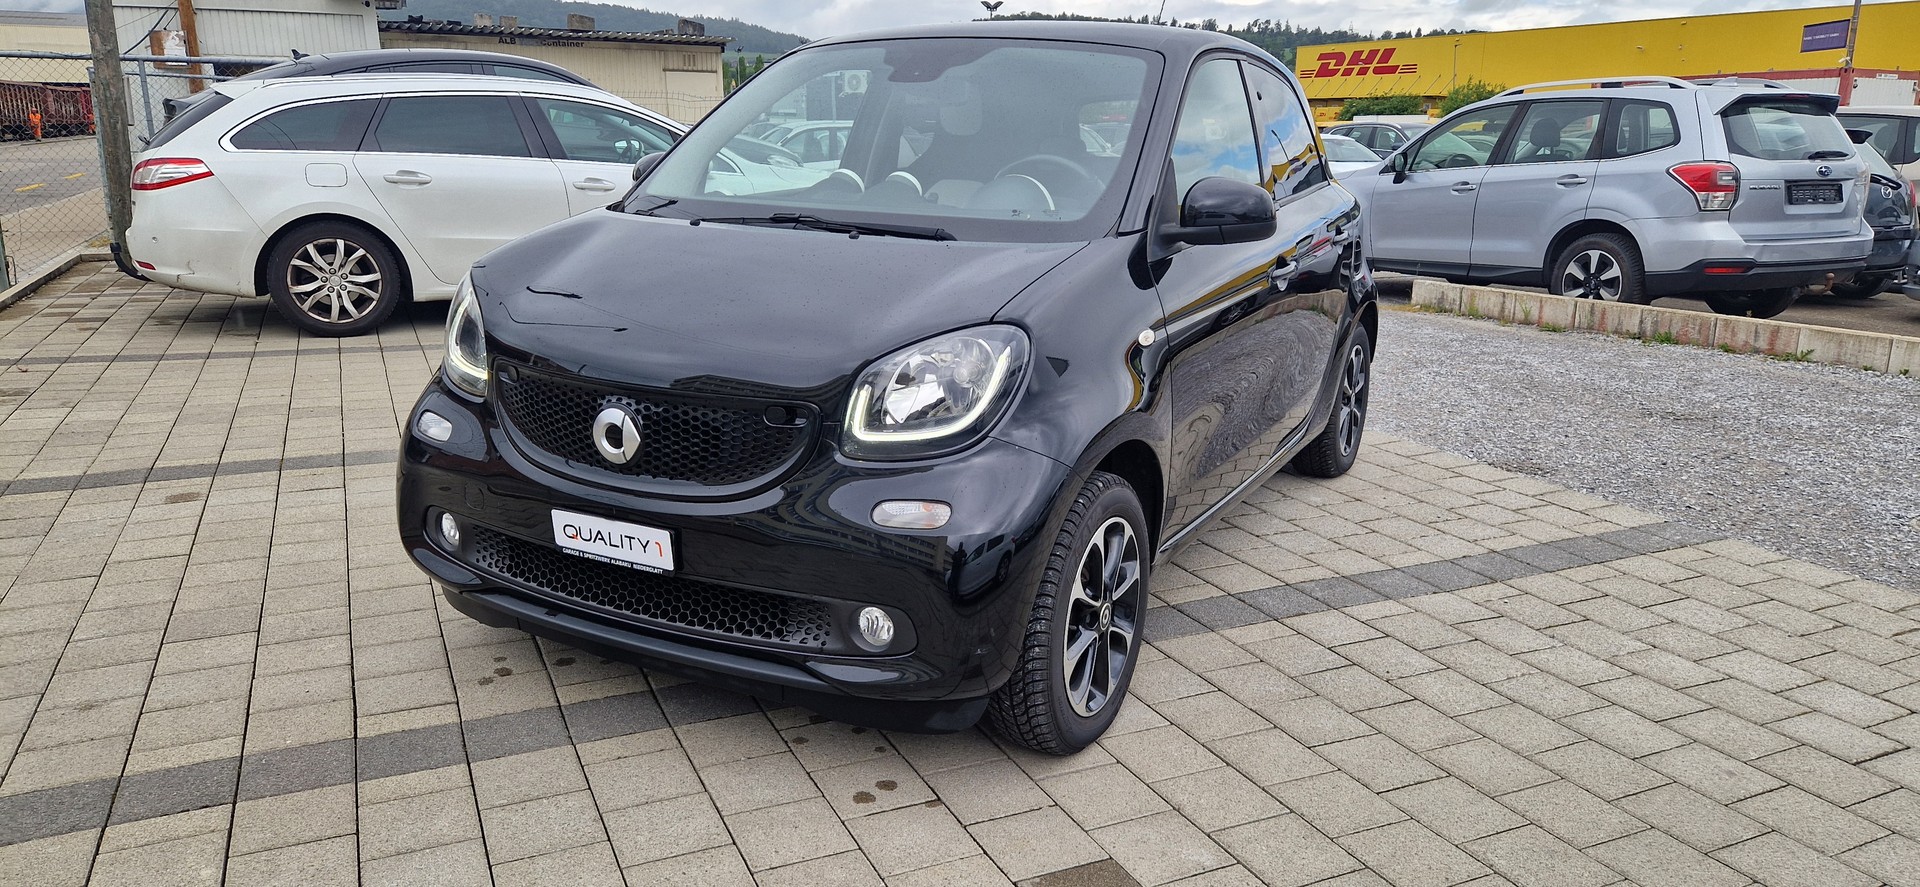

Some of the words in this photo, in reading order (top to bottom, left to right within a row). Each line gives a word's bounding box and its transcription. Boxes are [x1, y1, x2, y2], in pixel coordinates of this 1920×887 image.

[498, 36, 516, 45] ALB
[541, 39, 585, 48] Container
[1314, 48, 1400, 78] DHL
[563, 524, 650, 553] QUALITY
[655, 541, 663, 557] 1
[562, 547, 580, 557] GARAGE
